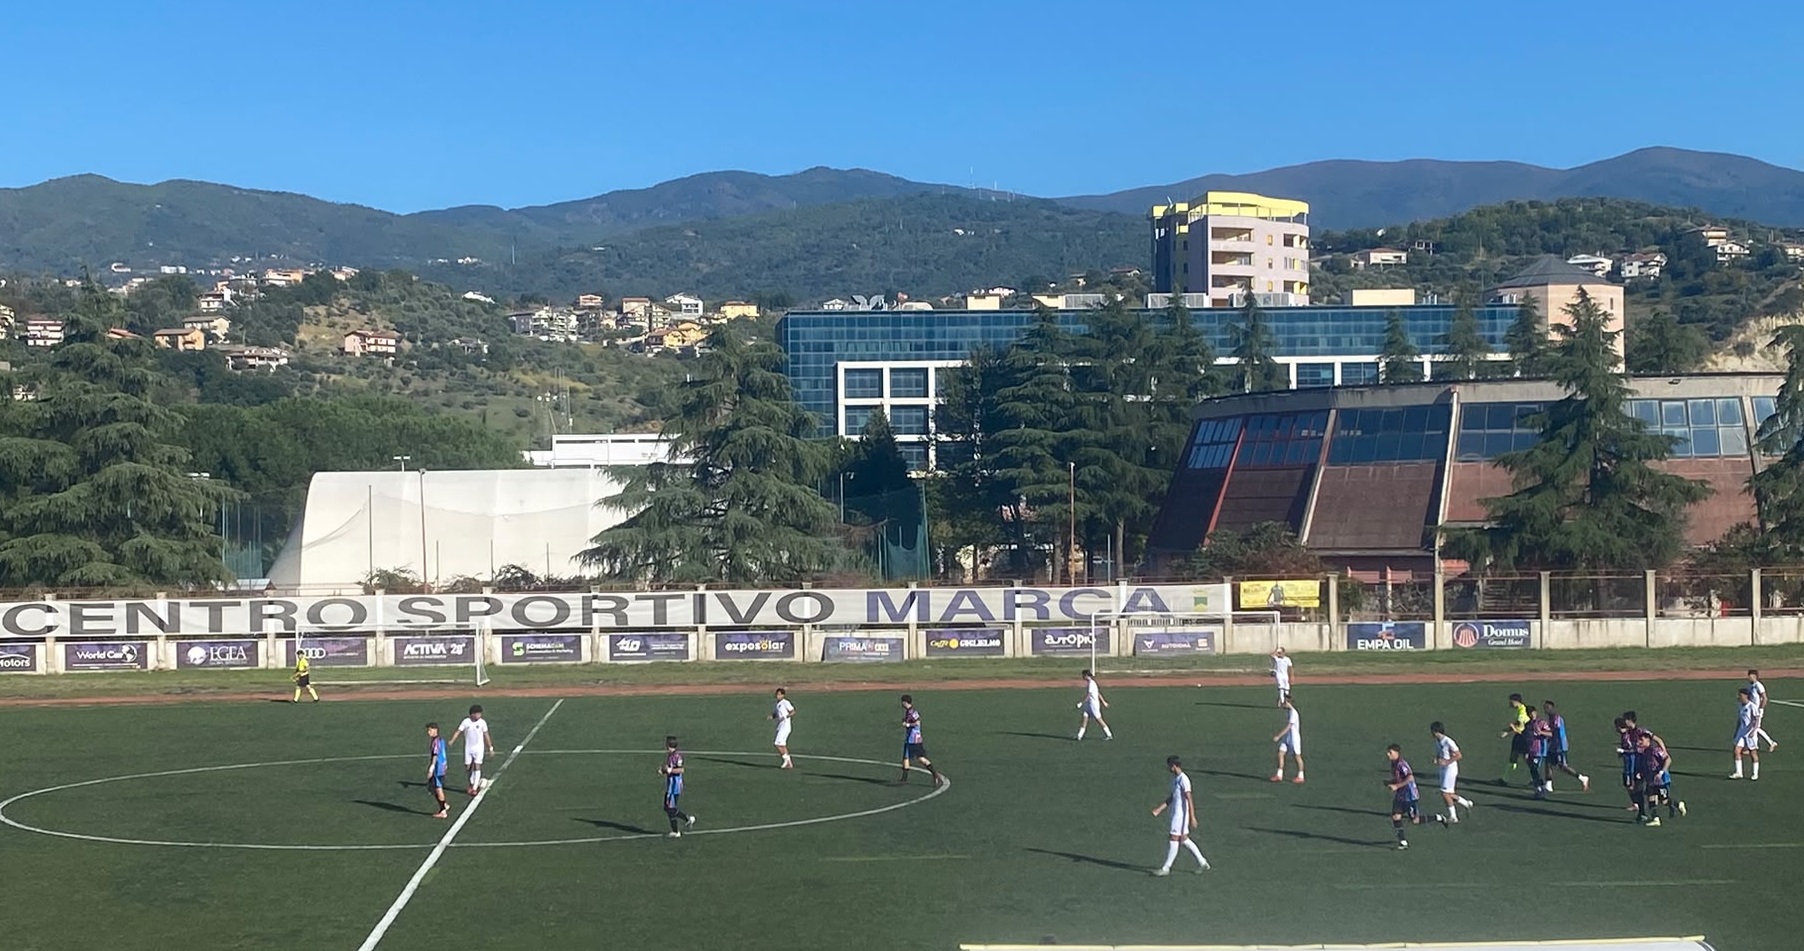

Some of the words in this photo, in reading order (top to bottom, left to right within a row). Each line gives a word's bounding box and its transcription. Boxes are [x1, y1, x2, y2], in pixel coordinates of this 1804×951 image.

[2, 598, 367, 635] CENTRO
[397, 590, 835, 628] SPORTIVO
[867, 588, 1173, 622] MARCA
[1483, 624, 1528, 637] Domus
[404, 643, 447, 655] ACTIVA
[725, 639, 785, 652] exposolar
[1358, 639, 1390, 649] EMPA
[1394, 639, 1414, 649] OIL
[76, 650, 106, 659] World
